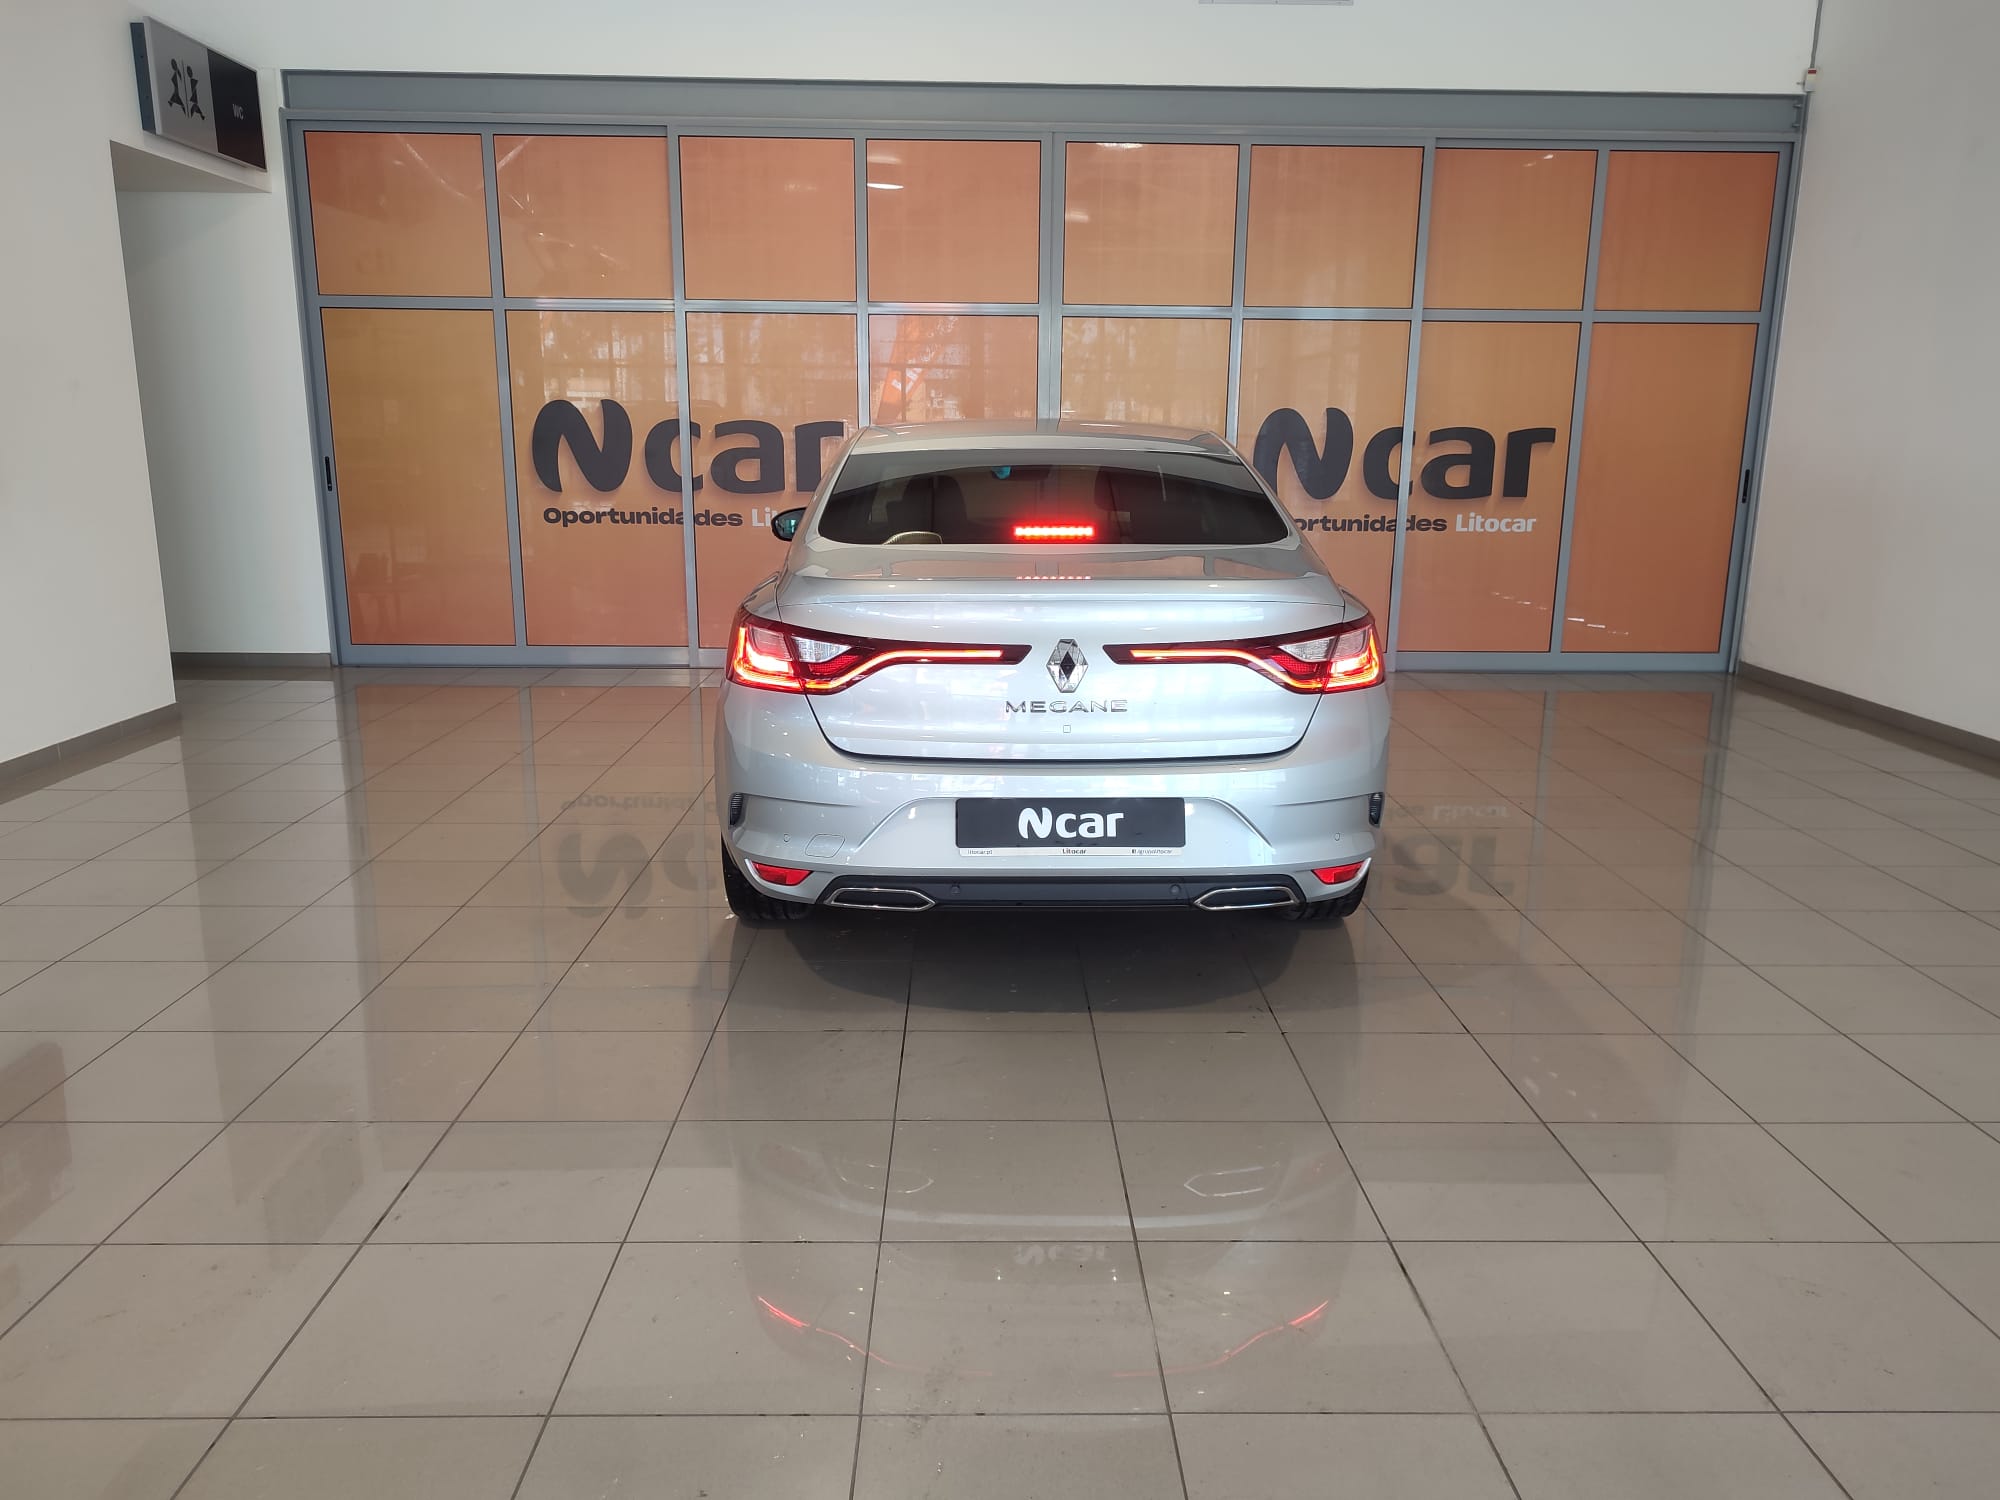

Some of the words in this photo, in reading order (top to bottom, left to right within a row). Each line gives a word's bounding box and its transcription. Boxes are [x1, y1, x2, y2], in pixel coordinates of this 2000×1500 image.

[232, 103, 244, 120] WC
[532, 398, 844, 494] Ncar
[1253, 407, 1556, 500] Ncar
[543, 507, 743, 527] Oportunidades
[1295, 514, 1447, 532] ortunidades
[1455, 512, 1537, 532] Litocar
[1005, 700, 1128, 713] MEGANE
[1018, 807, 1125, 839] Ncar
[1062, 847, 1087, 855] Litocar
